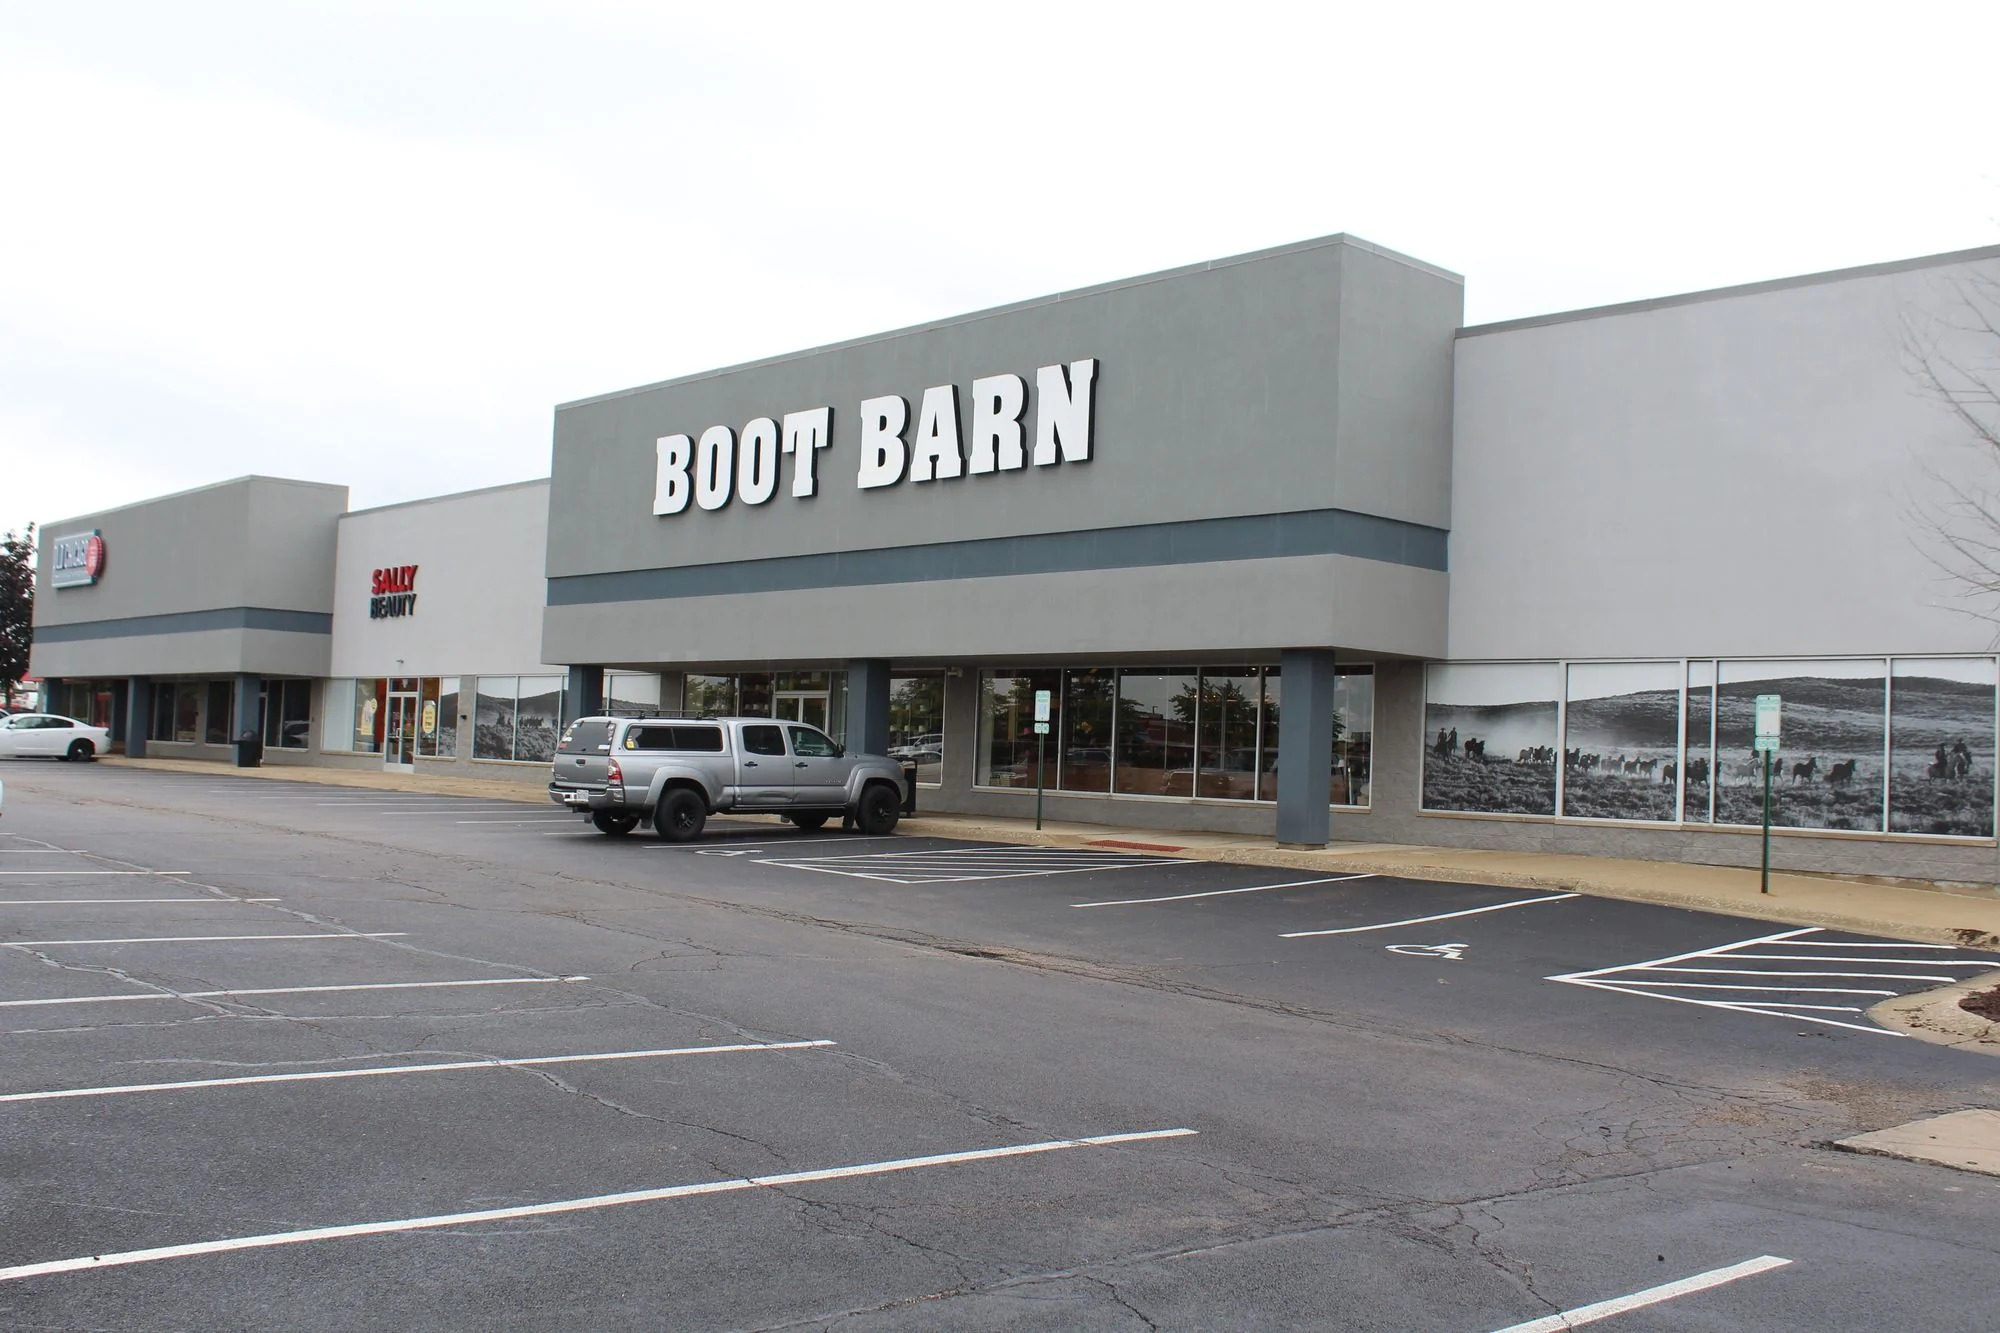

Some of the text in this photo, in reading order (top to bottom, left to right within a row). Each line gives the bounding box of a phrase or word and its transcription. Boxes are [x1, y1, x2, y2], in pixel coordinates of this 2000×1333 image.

[653, 358, 1099, 516] BOOT BARN
[371, 565, 418, 595] SALLY
[370, 594, 417, 619] BEAUTY
